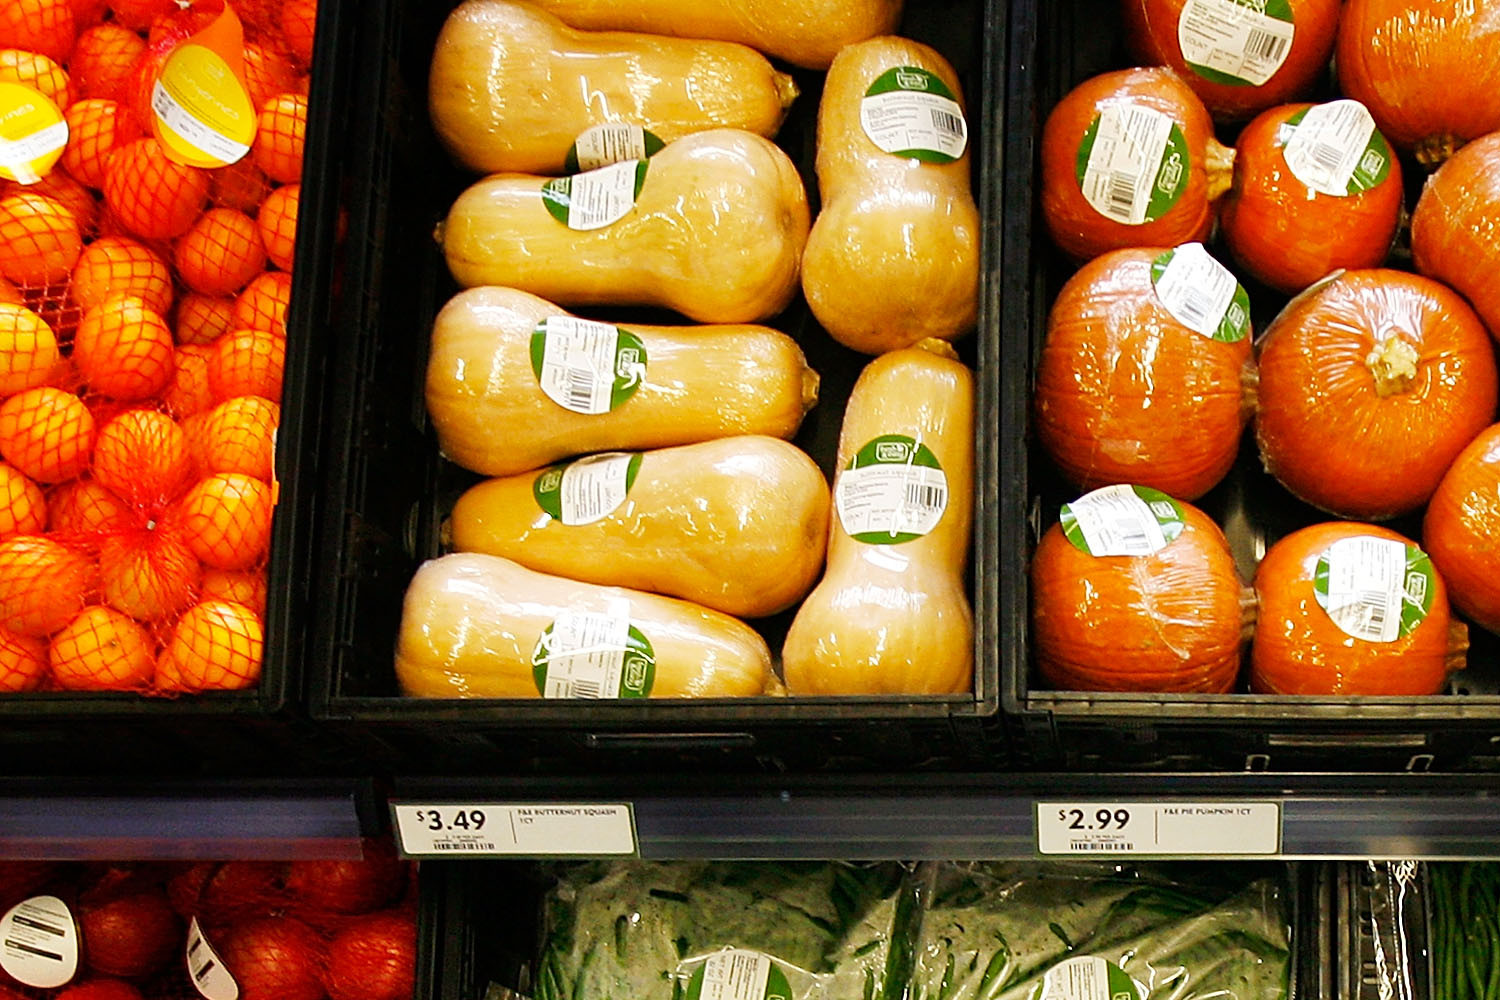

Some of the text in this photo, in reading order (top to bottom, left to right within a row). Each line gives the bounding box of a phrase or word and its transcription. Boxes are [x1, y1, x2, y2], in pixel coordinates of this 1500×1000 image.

[534, 808, 581, 817] BUTTERNUT
[583, 809, 617, 818] SQUASH
[1059, 808, 1130, 830] $2.99
[1196, 808, 1233, 816] PUMPKIN
[417, 810, 486, 831] $3.49
